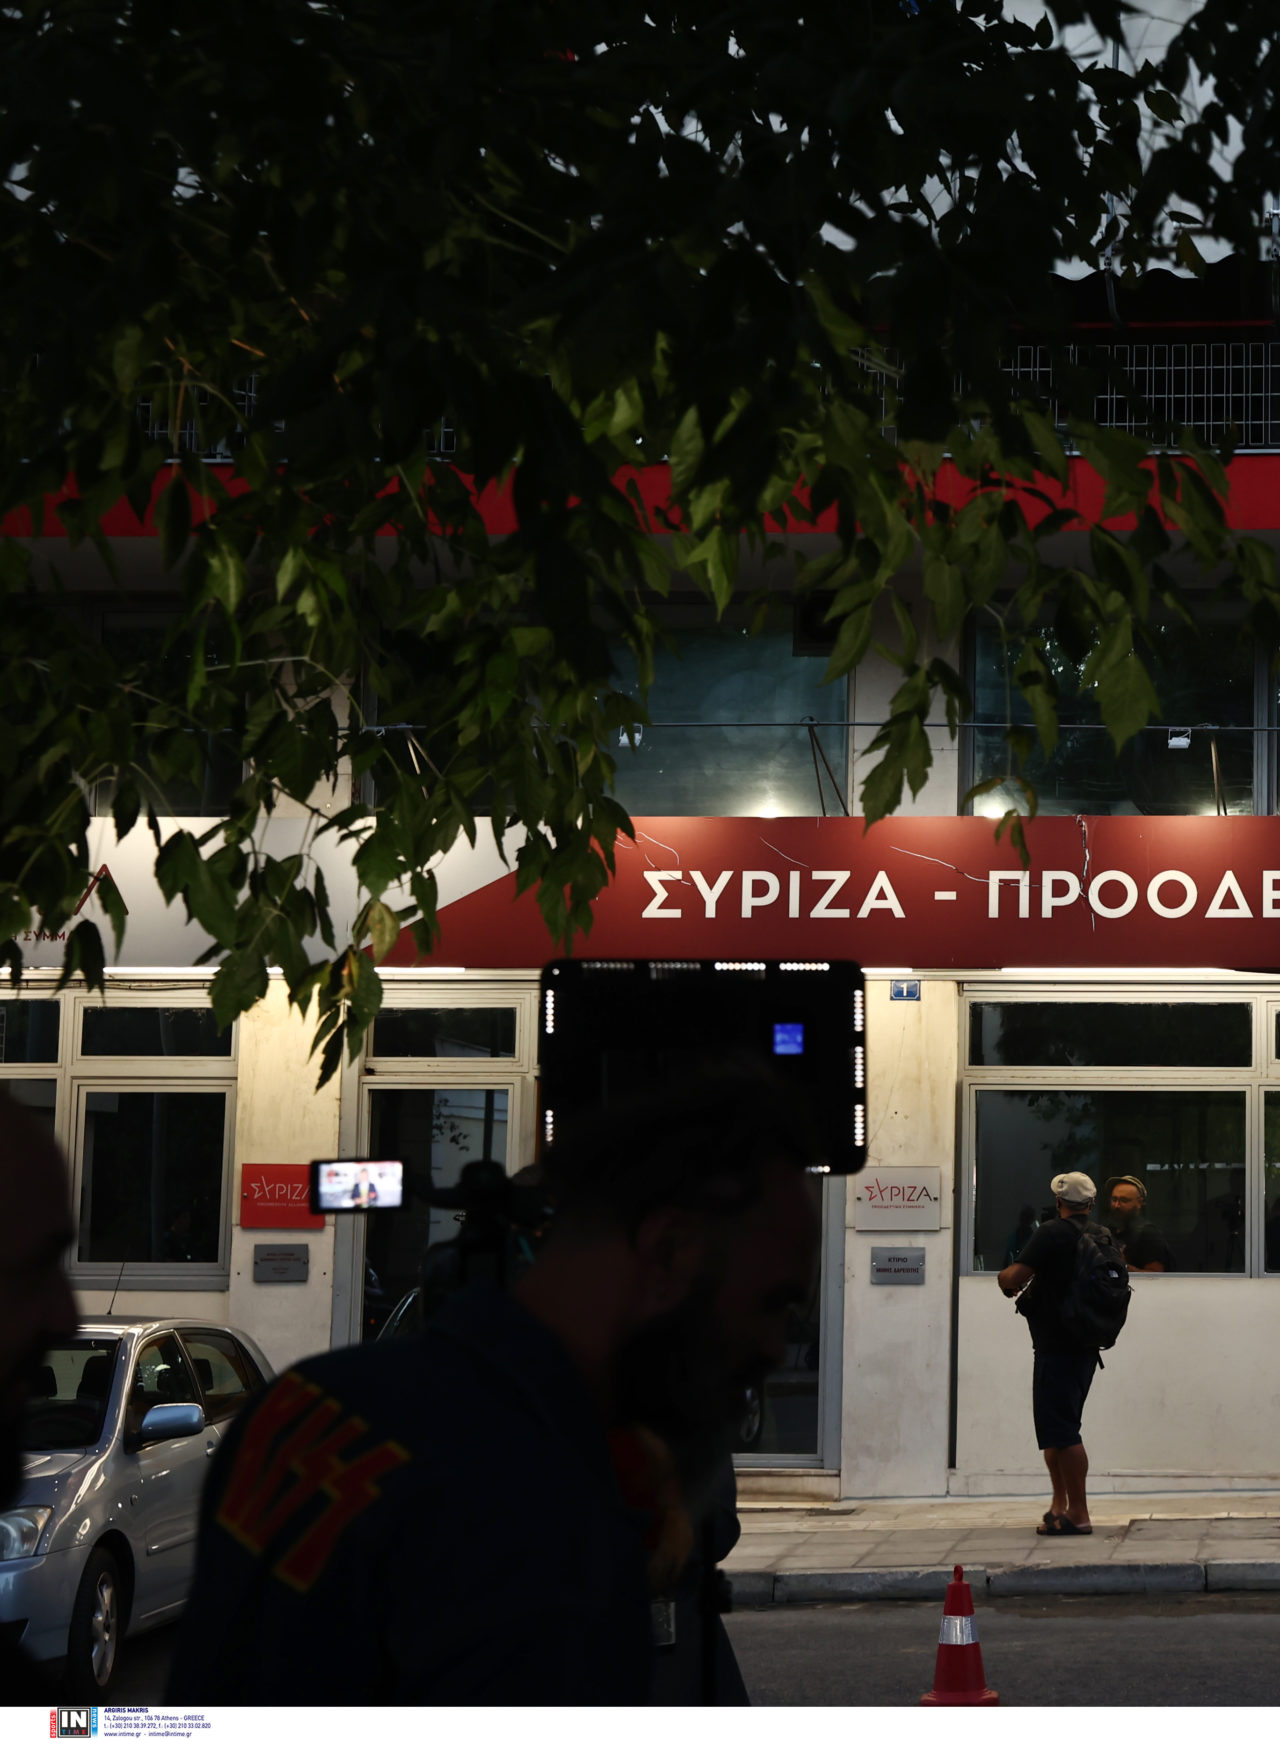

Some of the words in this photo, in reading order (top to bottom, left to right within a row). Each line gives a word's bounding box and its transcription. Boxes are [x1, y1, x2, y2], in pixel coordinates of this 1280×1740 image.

[640, 869, 907, 919] ΣΥΡΙΖΑ
[934, 890, 958, 901] -
[900, 982, 908, 997] 1
[864, 1177, 933, 1202] ΣΥΡΙΖΑ
